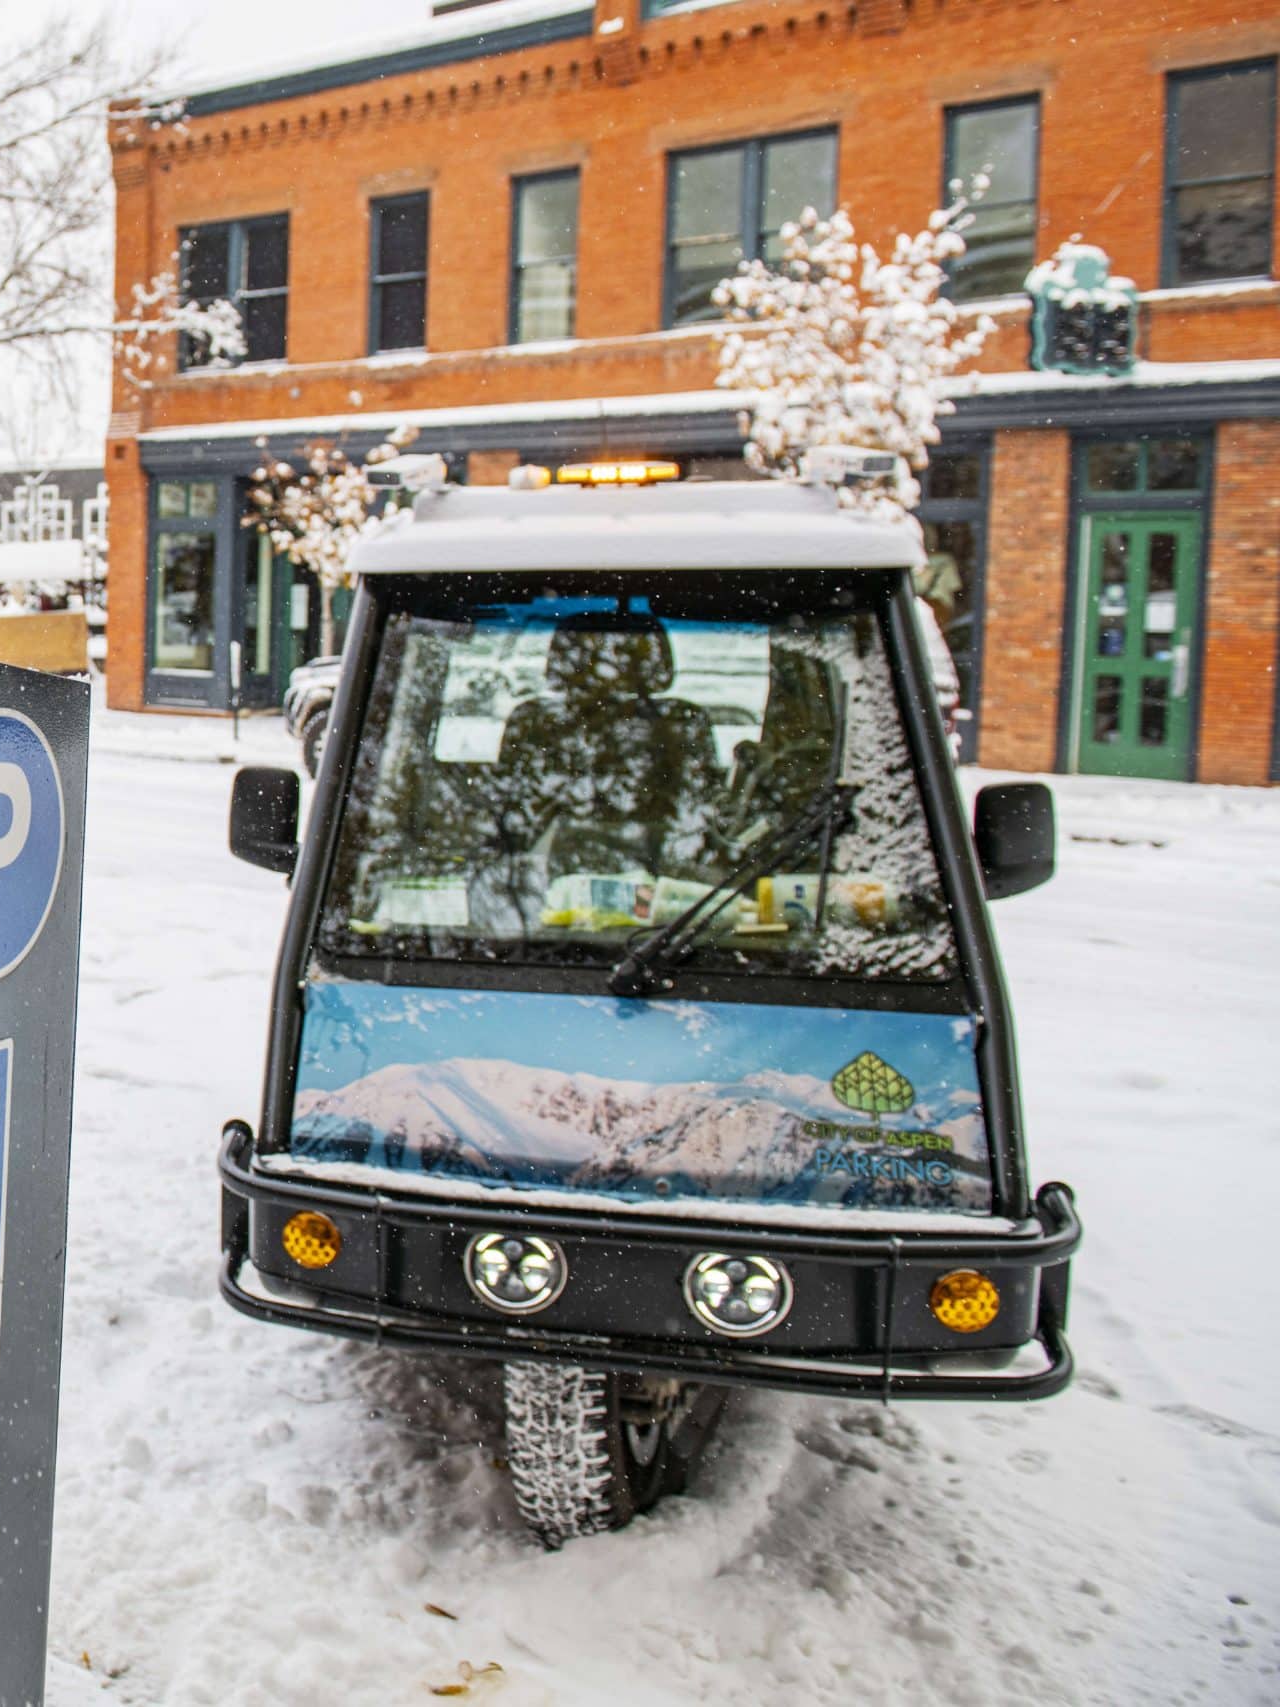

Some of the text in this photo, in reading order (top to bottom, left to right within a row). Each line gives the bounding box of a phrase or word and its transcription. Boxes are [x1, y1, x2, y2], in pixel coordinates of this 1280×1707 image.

[803, 1121, 953, 1150] CITY OF ASPEN
[815, 1149, 953, 1186] PARKING
